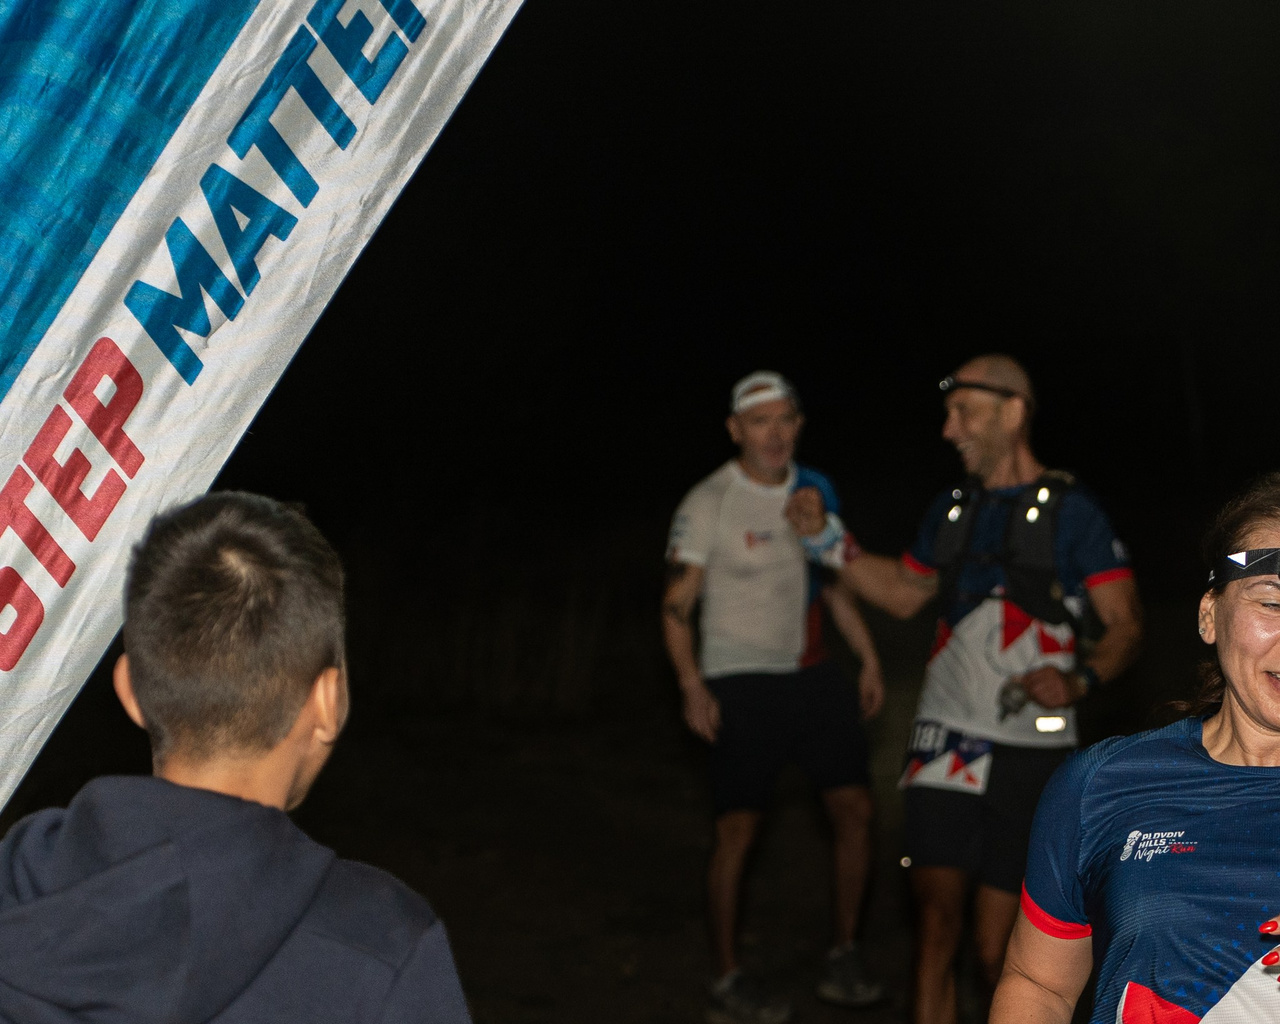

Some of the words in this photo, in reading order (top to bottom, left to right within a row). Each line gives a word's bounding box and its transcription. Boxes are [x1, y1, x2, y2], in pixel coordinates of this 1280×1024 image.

[123, 0, 426, 387] MATTE
[1141, 830, 1186, 841] PLOVDIV
[1138, 838, 1167, 849] HILLS
[1134, 845, 1171, 862] Night
[1170, 844, 1196, 854] Run
